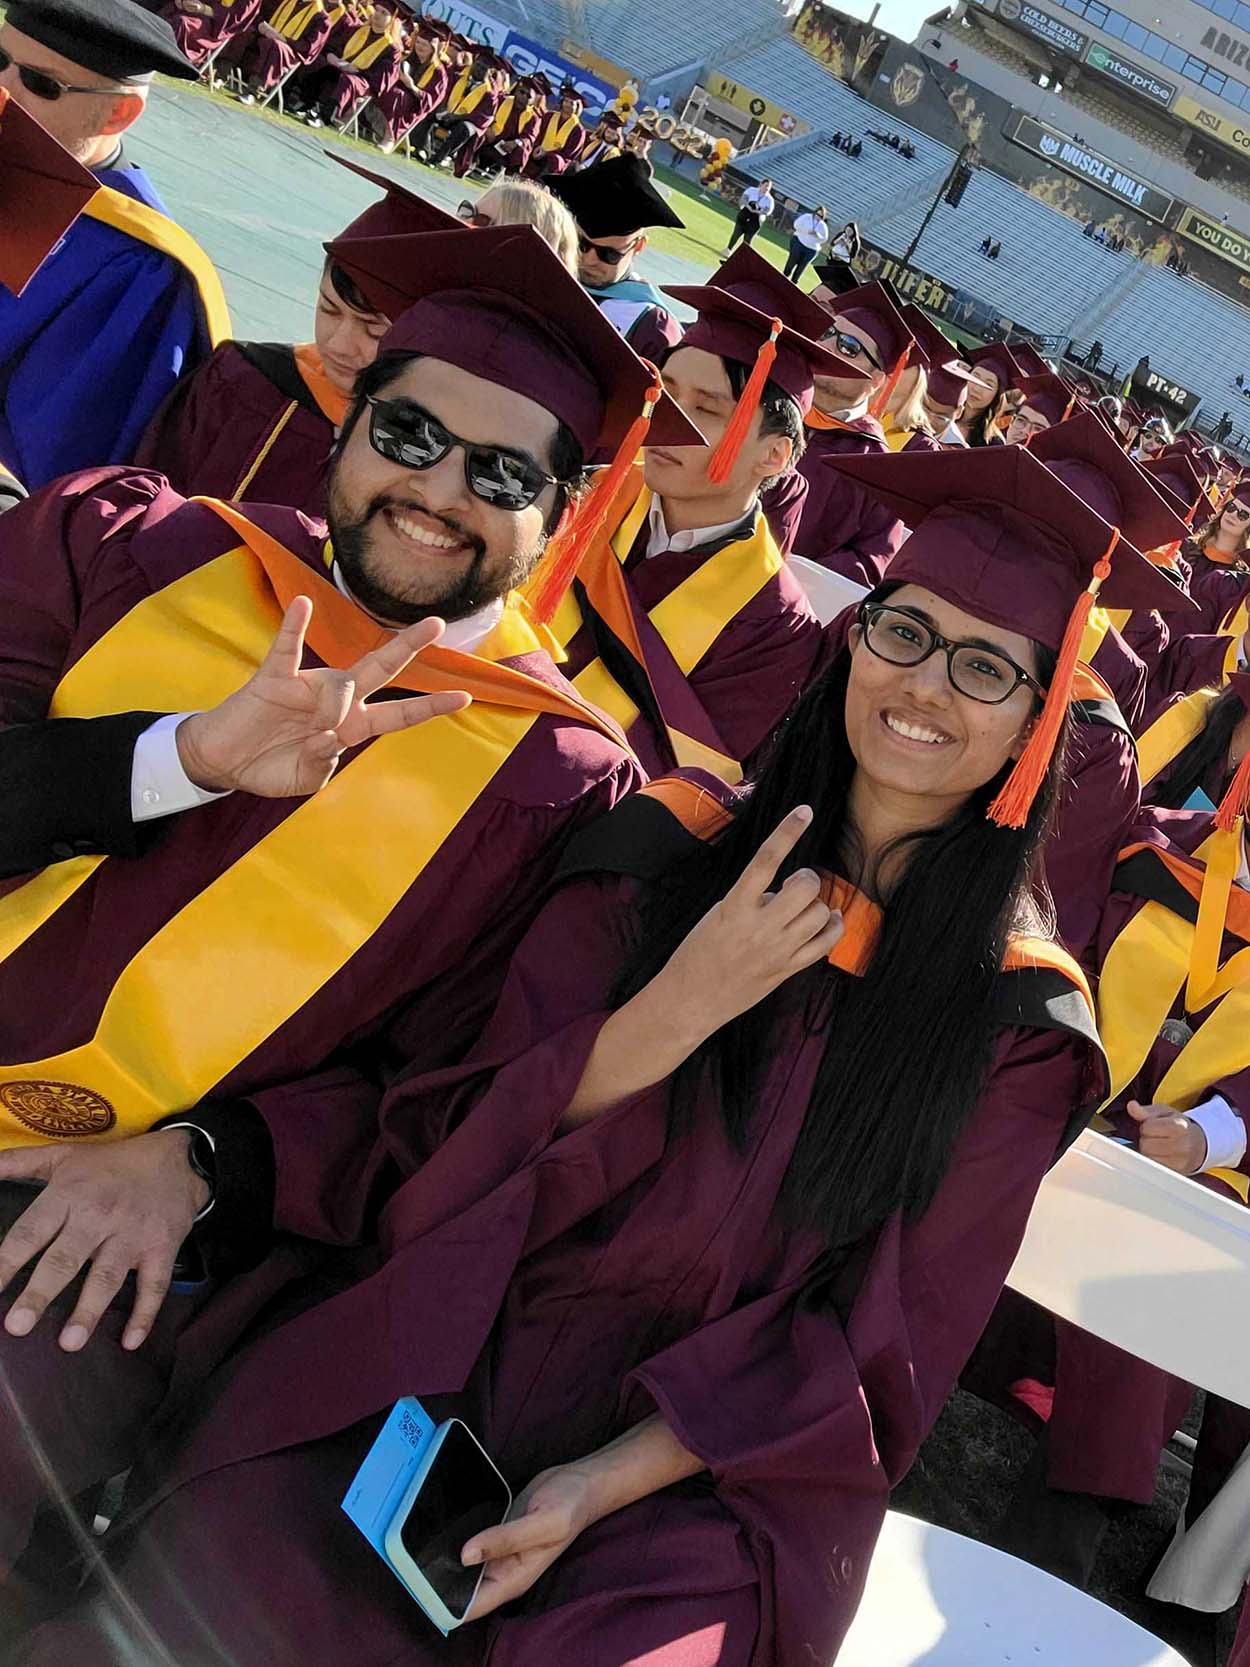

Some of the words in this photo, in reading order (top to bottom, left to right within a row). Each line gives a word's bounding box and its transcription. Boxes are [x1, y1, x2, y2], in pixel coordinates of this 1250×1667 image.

[1020, 13, 1081, 52] CHEESEBURGERS
[1023, 6, 1048, 24] COLD
[1048, 20, 1079, 41] BEERS
[1091, 51, 1170, 100] enterprise
[1195, 110, 1222, 131] ASU
[1059, 143, 1114, 185] MUSCLE
[1111, 171, 1149, 206] MILK
[1195, 222, 1221, 244] YOU
[1220, 238, 1242, 255] DO
